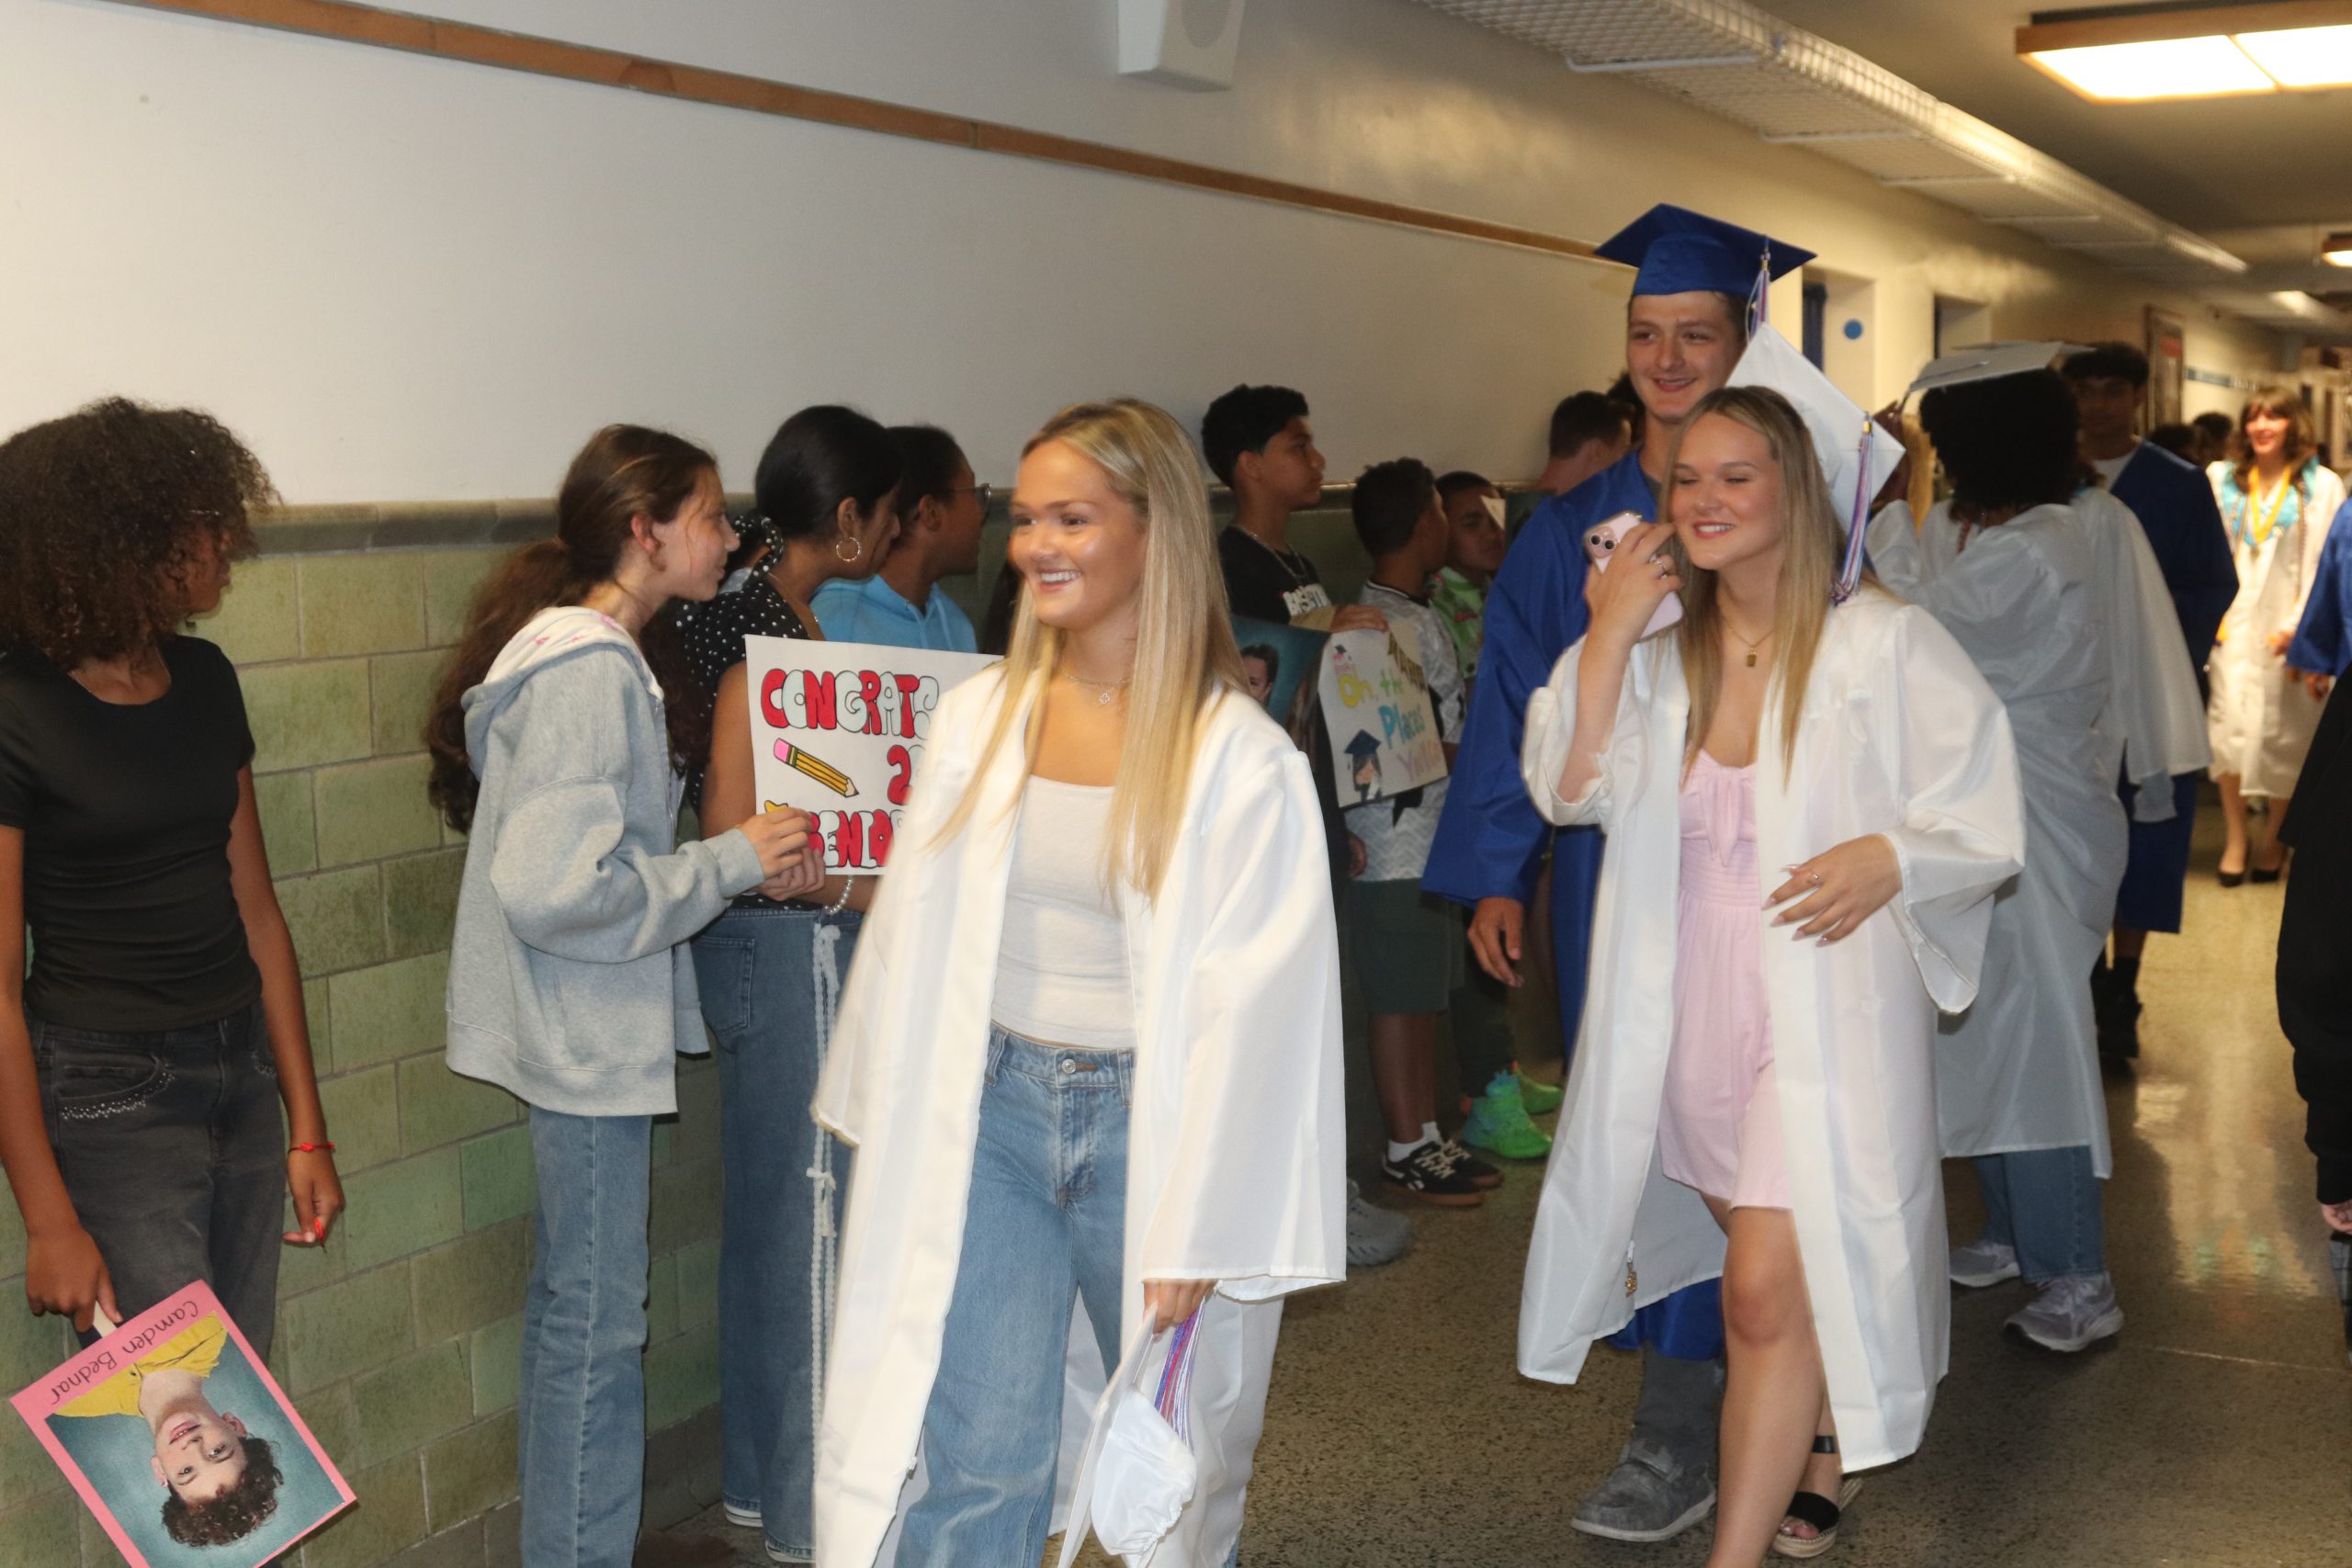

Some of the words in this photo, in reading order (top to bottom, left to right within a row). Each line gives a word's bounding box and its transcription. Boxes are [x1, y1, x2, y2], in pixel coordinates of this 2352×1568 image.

[761, 668, 939, 740] CONGRATS
[122, 1300, 199, 1355] Camden
[50, 1351, 118, 1404] Bednar
